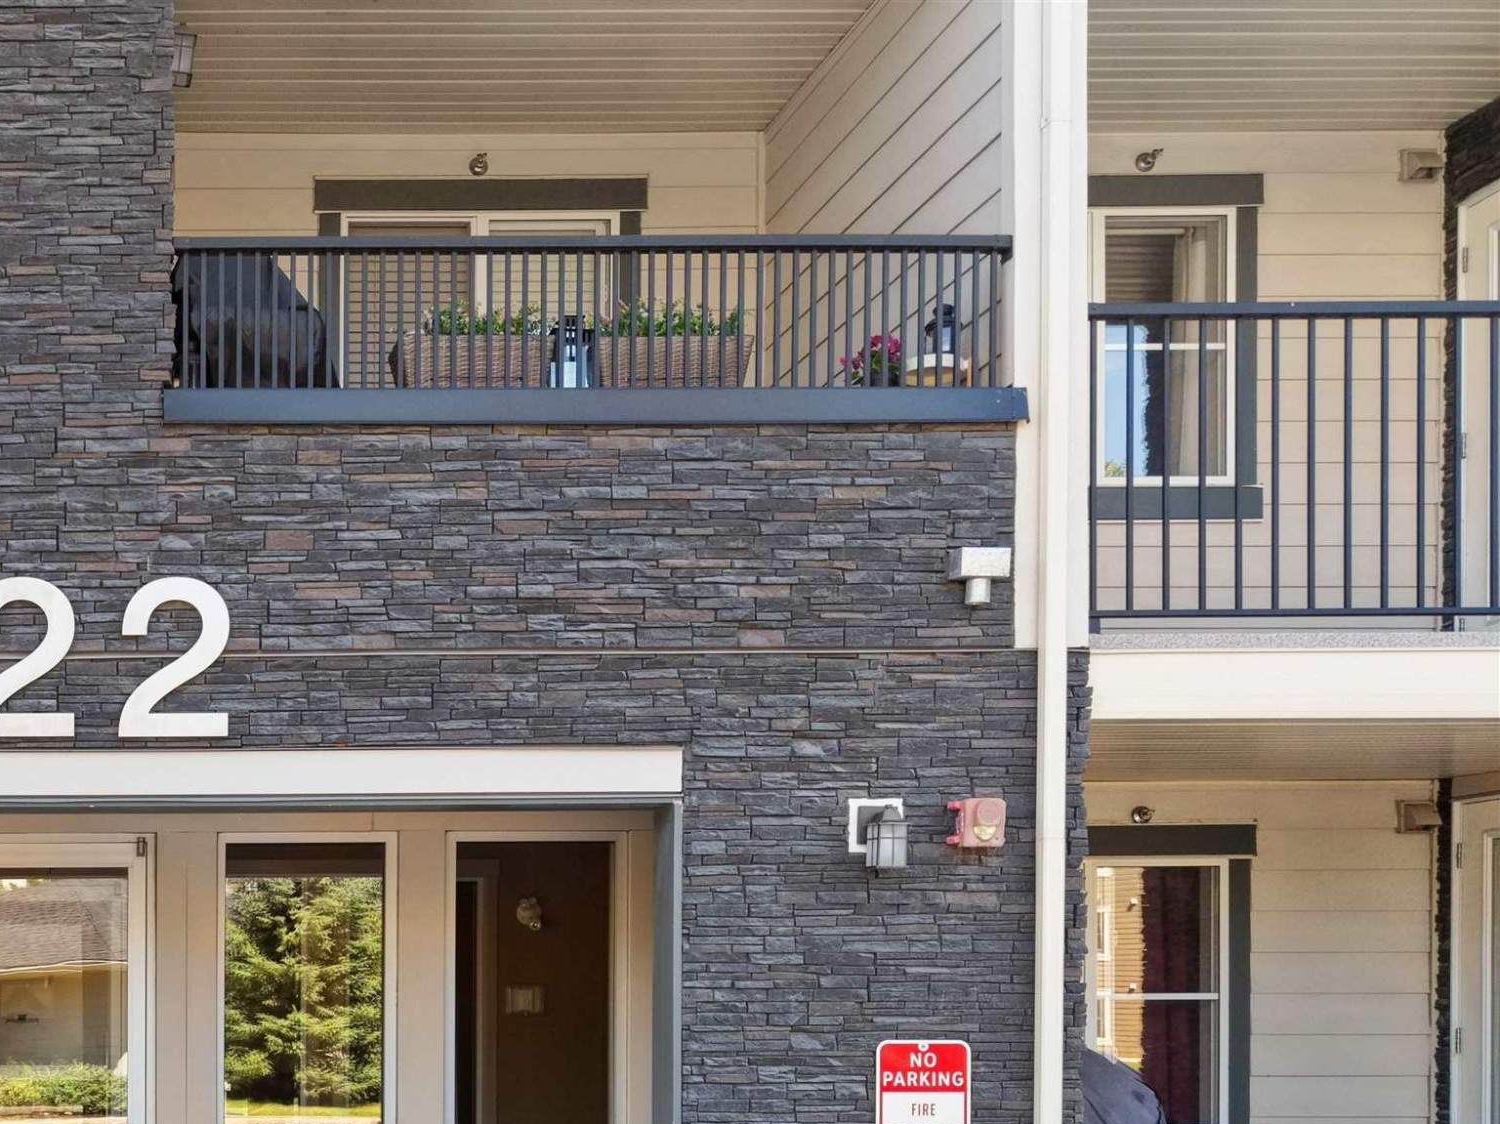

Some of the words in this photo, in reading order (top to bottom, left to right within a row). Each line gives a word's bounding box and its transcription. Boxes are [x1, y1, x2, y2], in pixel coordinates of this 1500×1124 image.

[909, 1052, 937, 1068] NO
[882, 1071, 964, 1087] PARKING
[911, 1103, 936, 1116] FIRE
